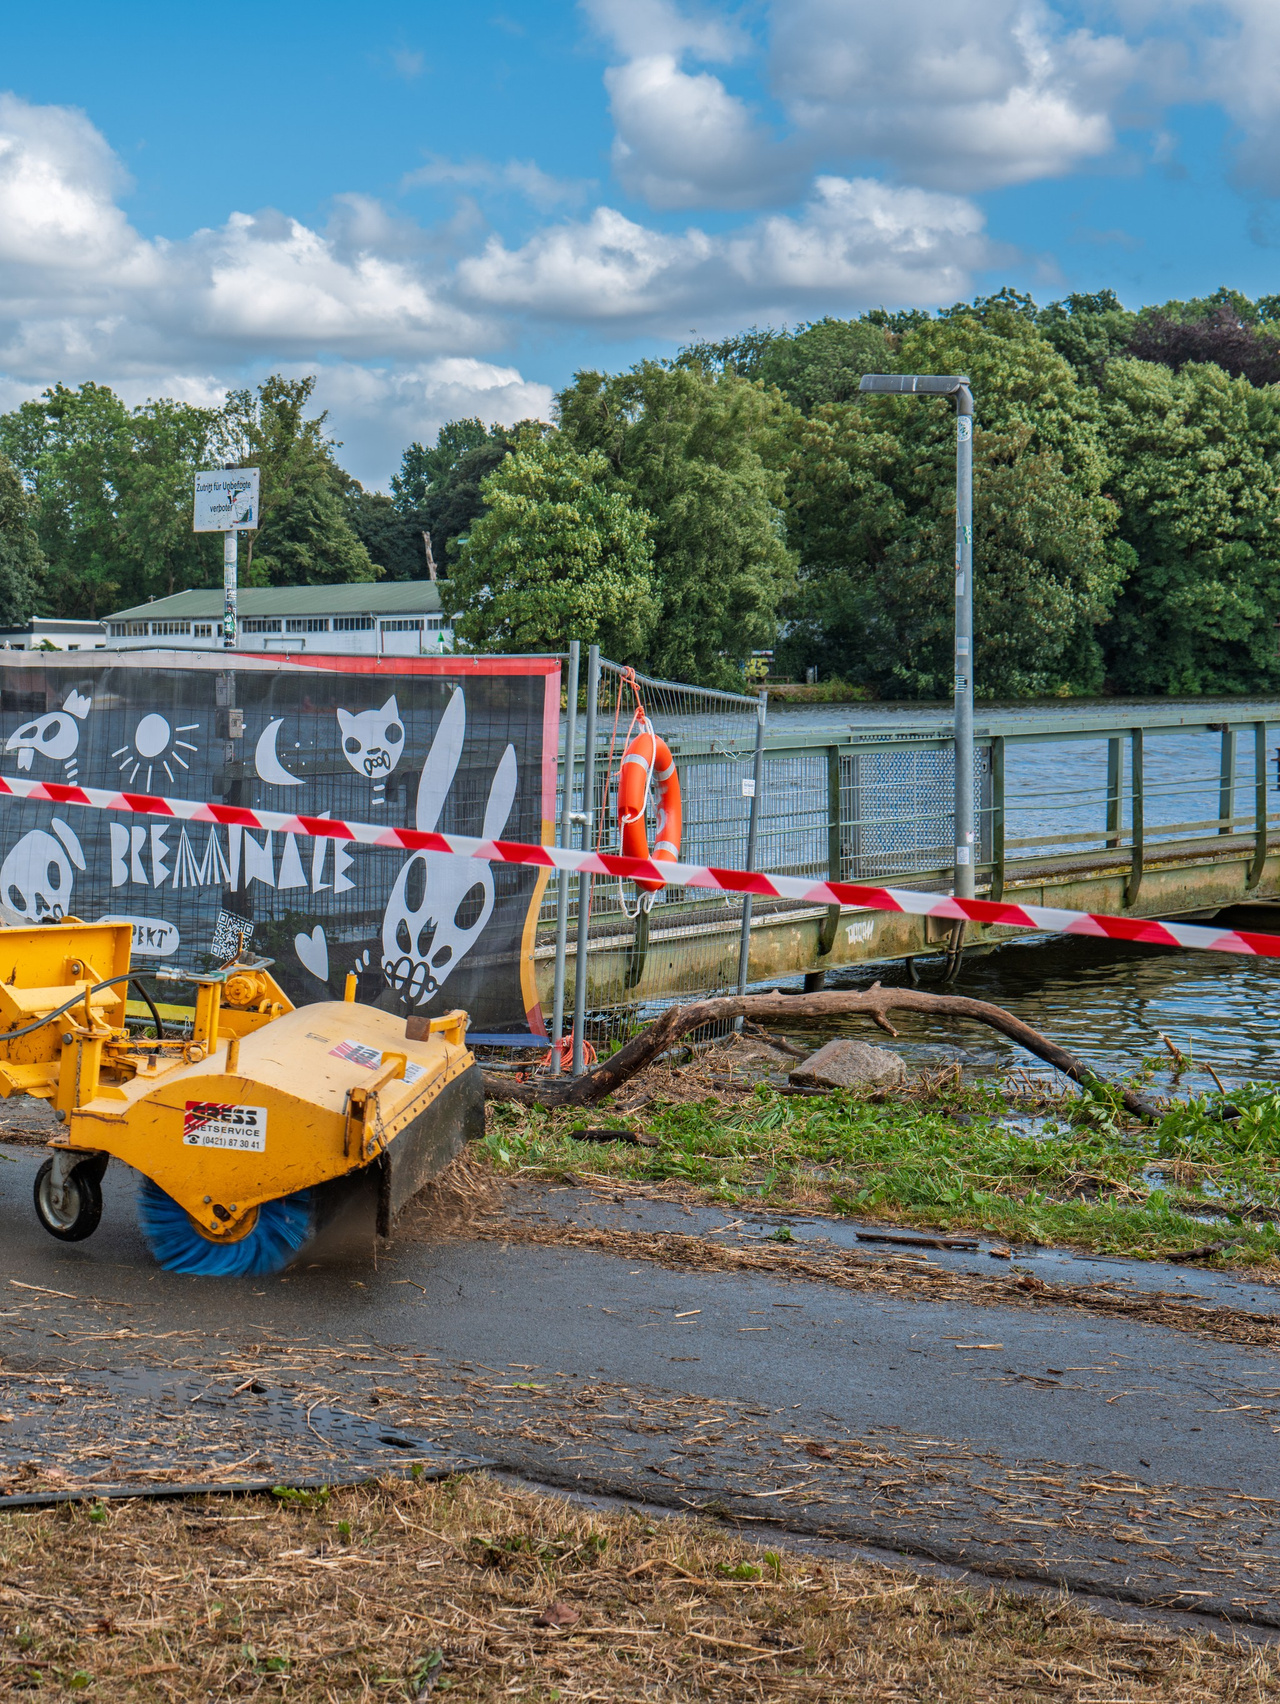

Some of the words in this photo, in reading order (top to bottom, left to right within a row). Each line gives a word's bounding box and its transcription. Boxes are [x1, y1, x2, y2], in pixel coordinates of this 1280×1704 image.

[214, 481, 222, 491] für
[110, 811, 357, 894] BREMINALE
[192, 1105, 258, 1126] GRESS
[187, 1123, 261, 1137] MIETSERVICE
[202, 1136, 227, 1148] (0421)
[228, 1138, 238, 1147] 87
[239, 1140, 250, 1148] 30
[251, 1141, 261, 1149] 41
